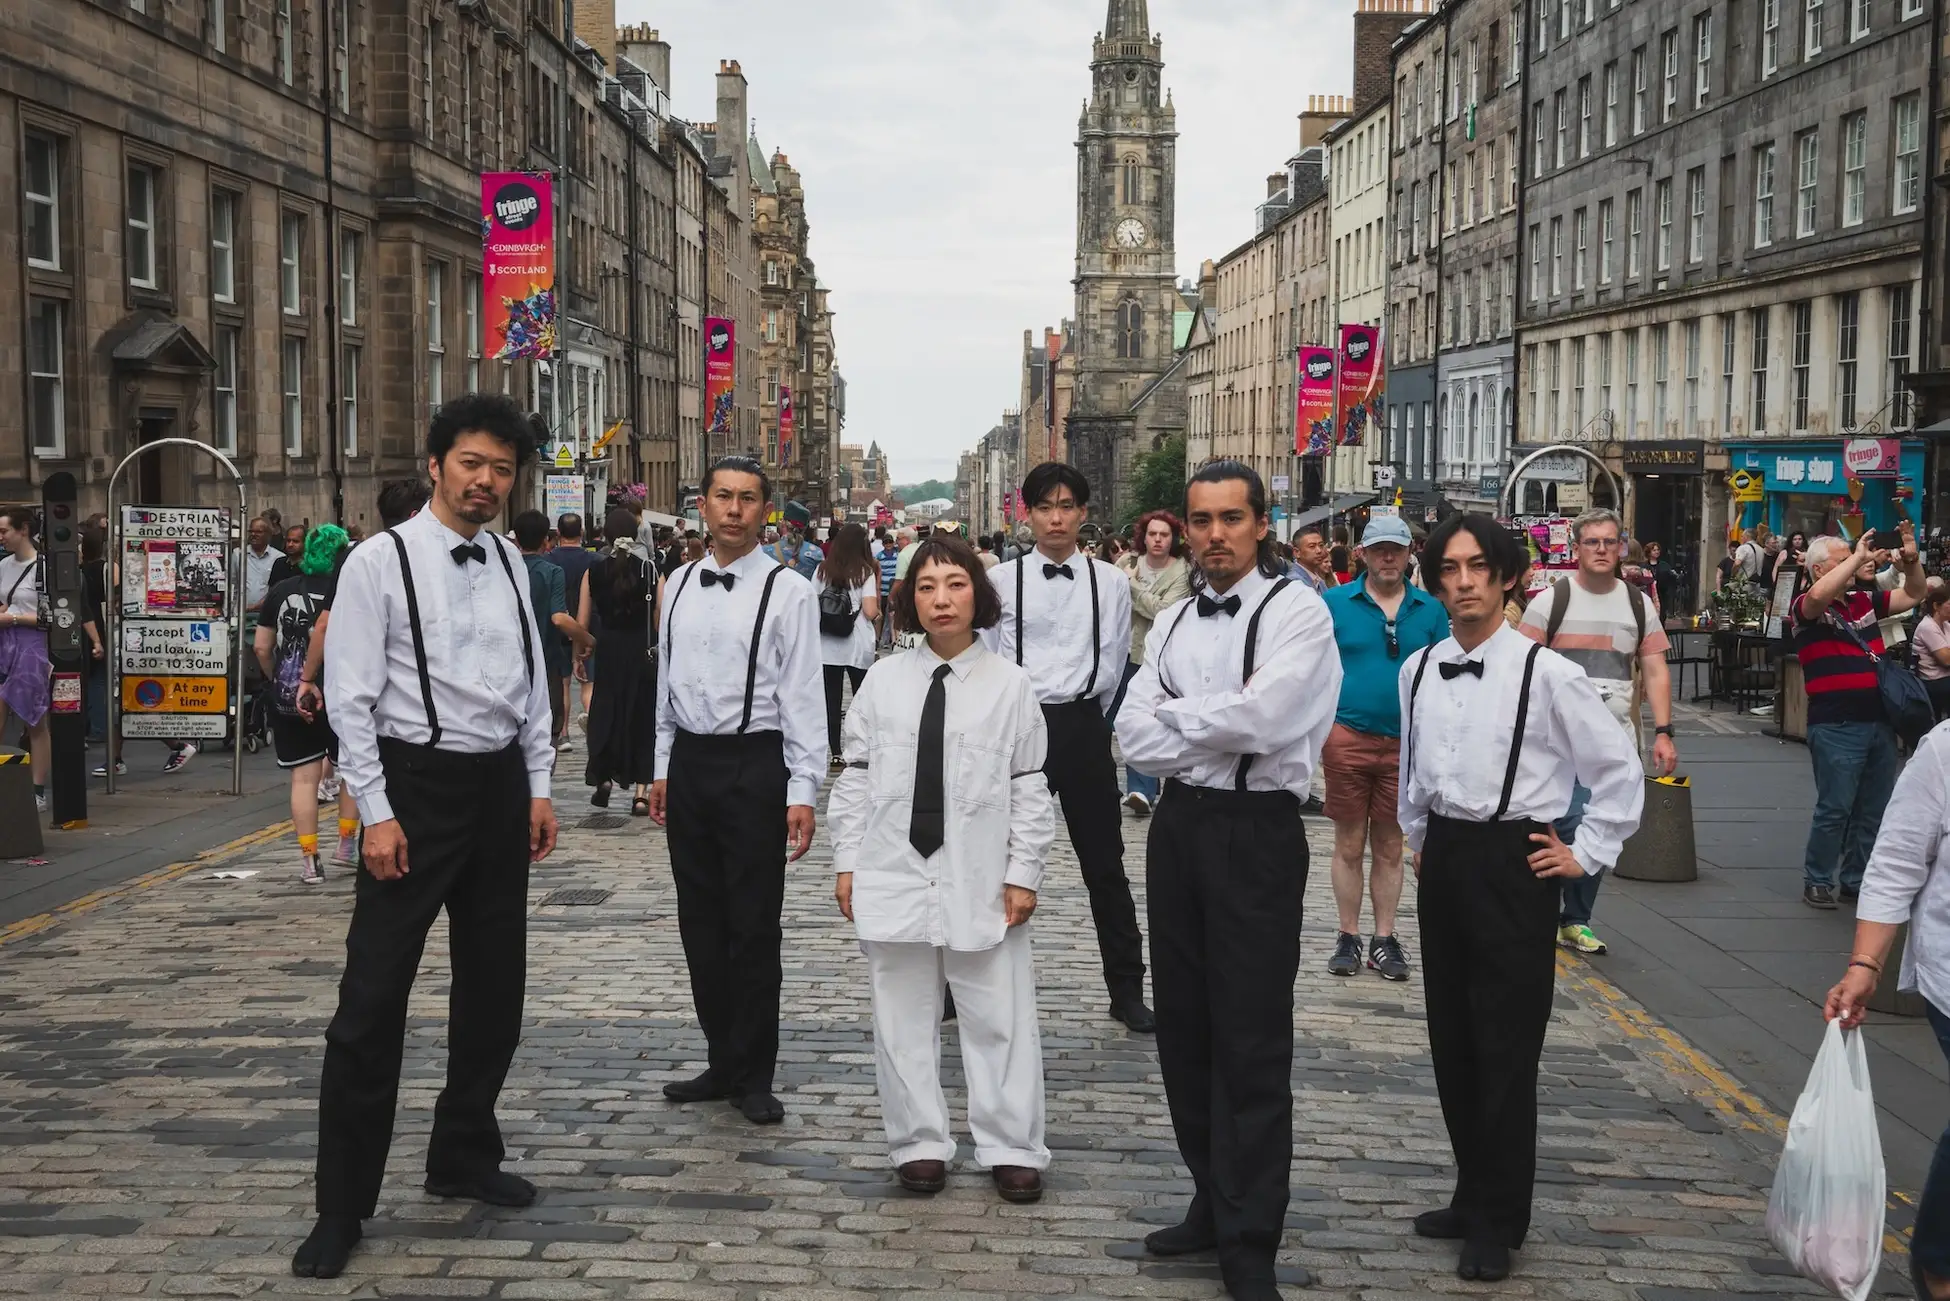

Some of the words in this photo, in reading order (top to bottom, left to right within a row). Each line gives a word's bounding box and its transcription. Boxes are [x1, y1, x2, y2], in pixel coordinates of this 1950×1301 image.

[496, 197, 537, 216] fringe
[497, 266, 547, 274] SCOTLAND
[1348, 341, 1369, 353] fringe
[1307, 361, 1332, 373] fringe
[1849, 447, 1879, 463] fringe
[1549, 461, 1575, 470] SCOTLAND
[1776, 456, 1805, 485] fringe
[1808, 457, 1834, 485] shop
[1482, 479, 1498, 489] 166
[149, 512, 220, 524] DESTRIAN
[138, 527, 162, 536] and
[166, 526, 212, 537] CYCLE
[142, 627, 184, 638] Except
[165, 644, 212, 656] loag
[173, 682, 188, 693] At
[193, 684, 215, 695] any
[180, 697, 208, 707] time
